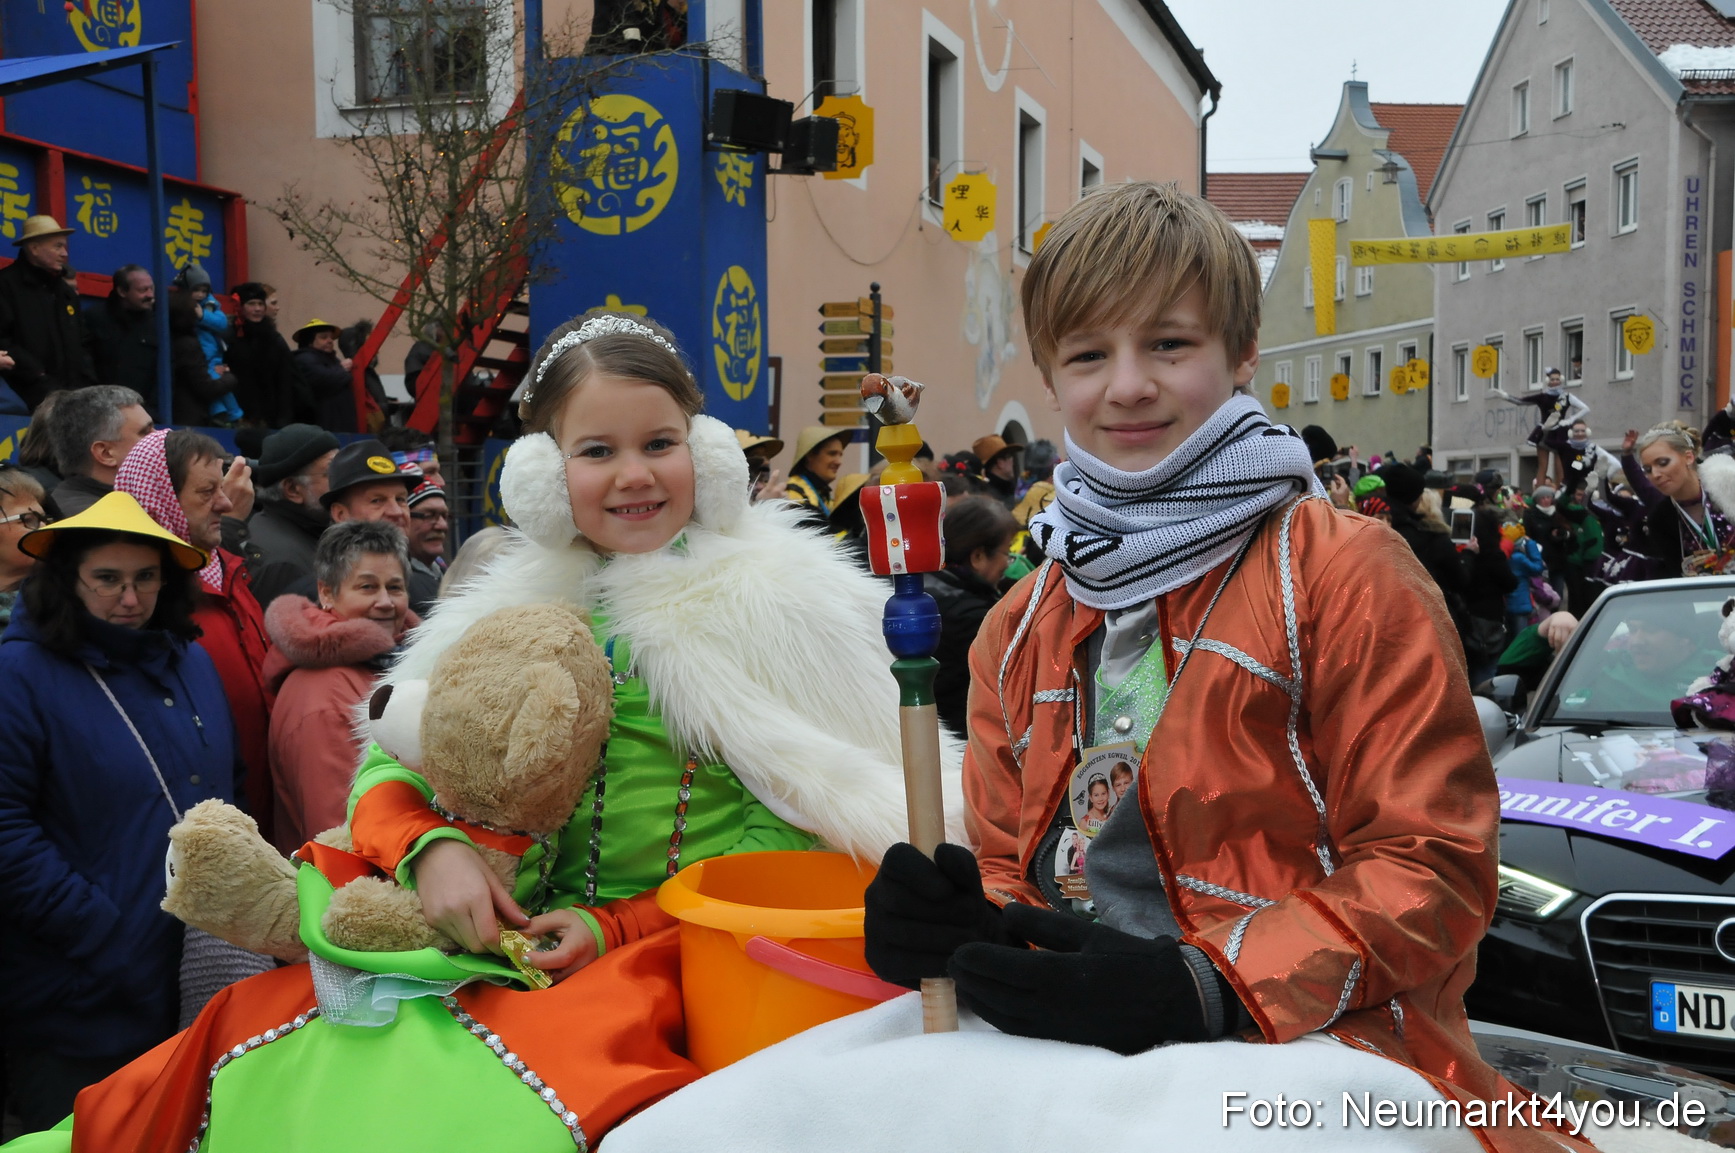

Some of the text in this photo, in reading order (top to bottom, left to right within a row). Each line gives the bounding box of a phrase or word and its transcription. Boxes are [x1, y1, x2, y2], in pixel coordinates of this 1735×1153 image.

[951, 219, 962, 232] 人
[1680, 177, 1700, 407] UHREN SCHMUCK
[1484, 407, 1530, 438] OPTIK
[1129, 756, 1141, 767] 201
[1660, 991, 1726, 1031] D ND
